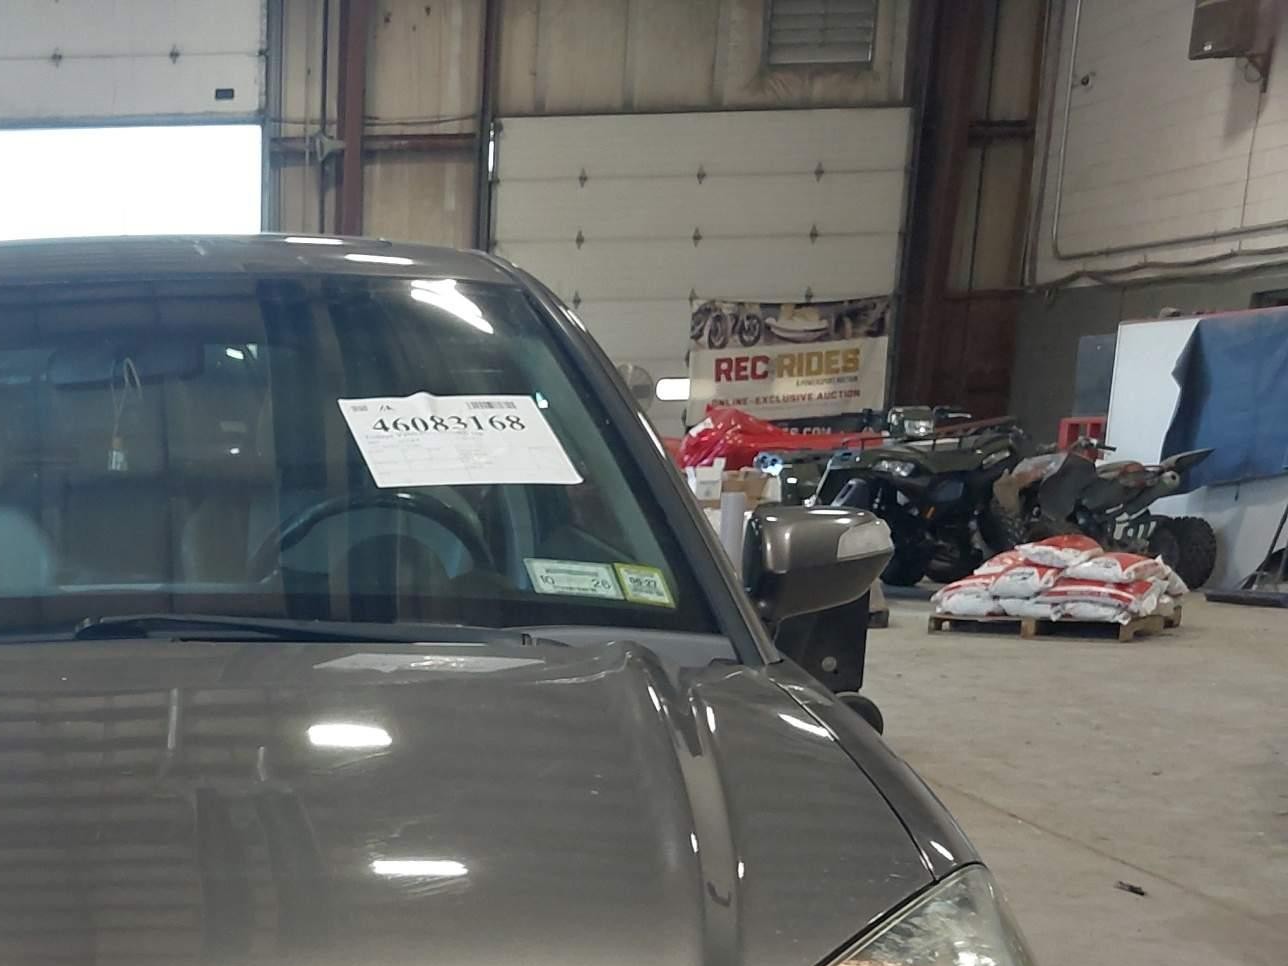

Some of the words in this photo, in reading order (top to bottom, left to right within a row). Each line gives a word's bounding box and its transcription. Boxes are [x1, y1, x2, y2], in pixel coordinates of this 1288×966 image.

[715, 355, 770, 382] REC
[776, 348, 860, 378] RIDES
[816, 389, 861, 400] AUCTION
[372, 414, 527, 434] 46083168
